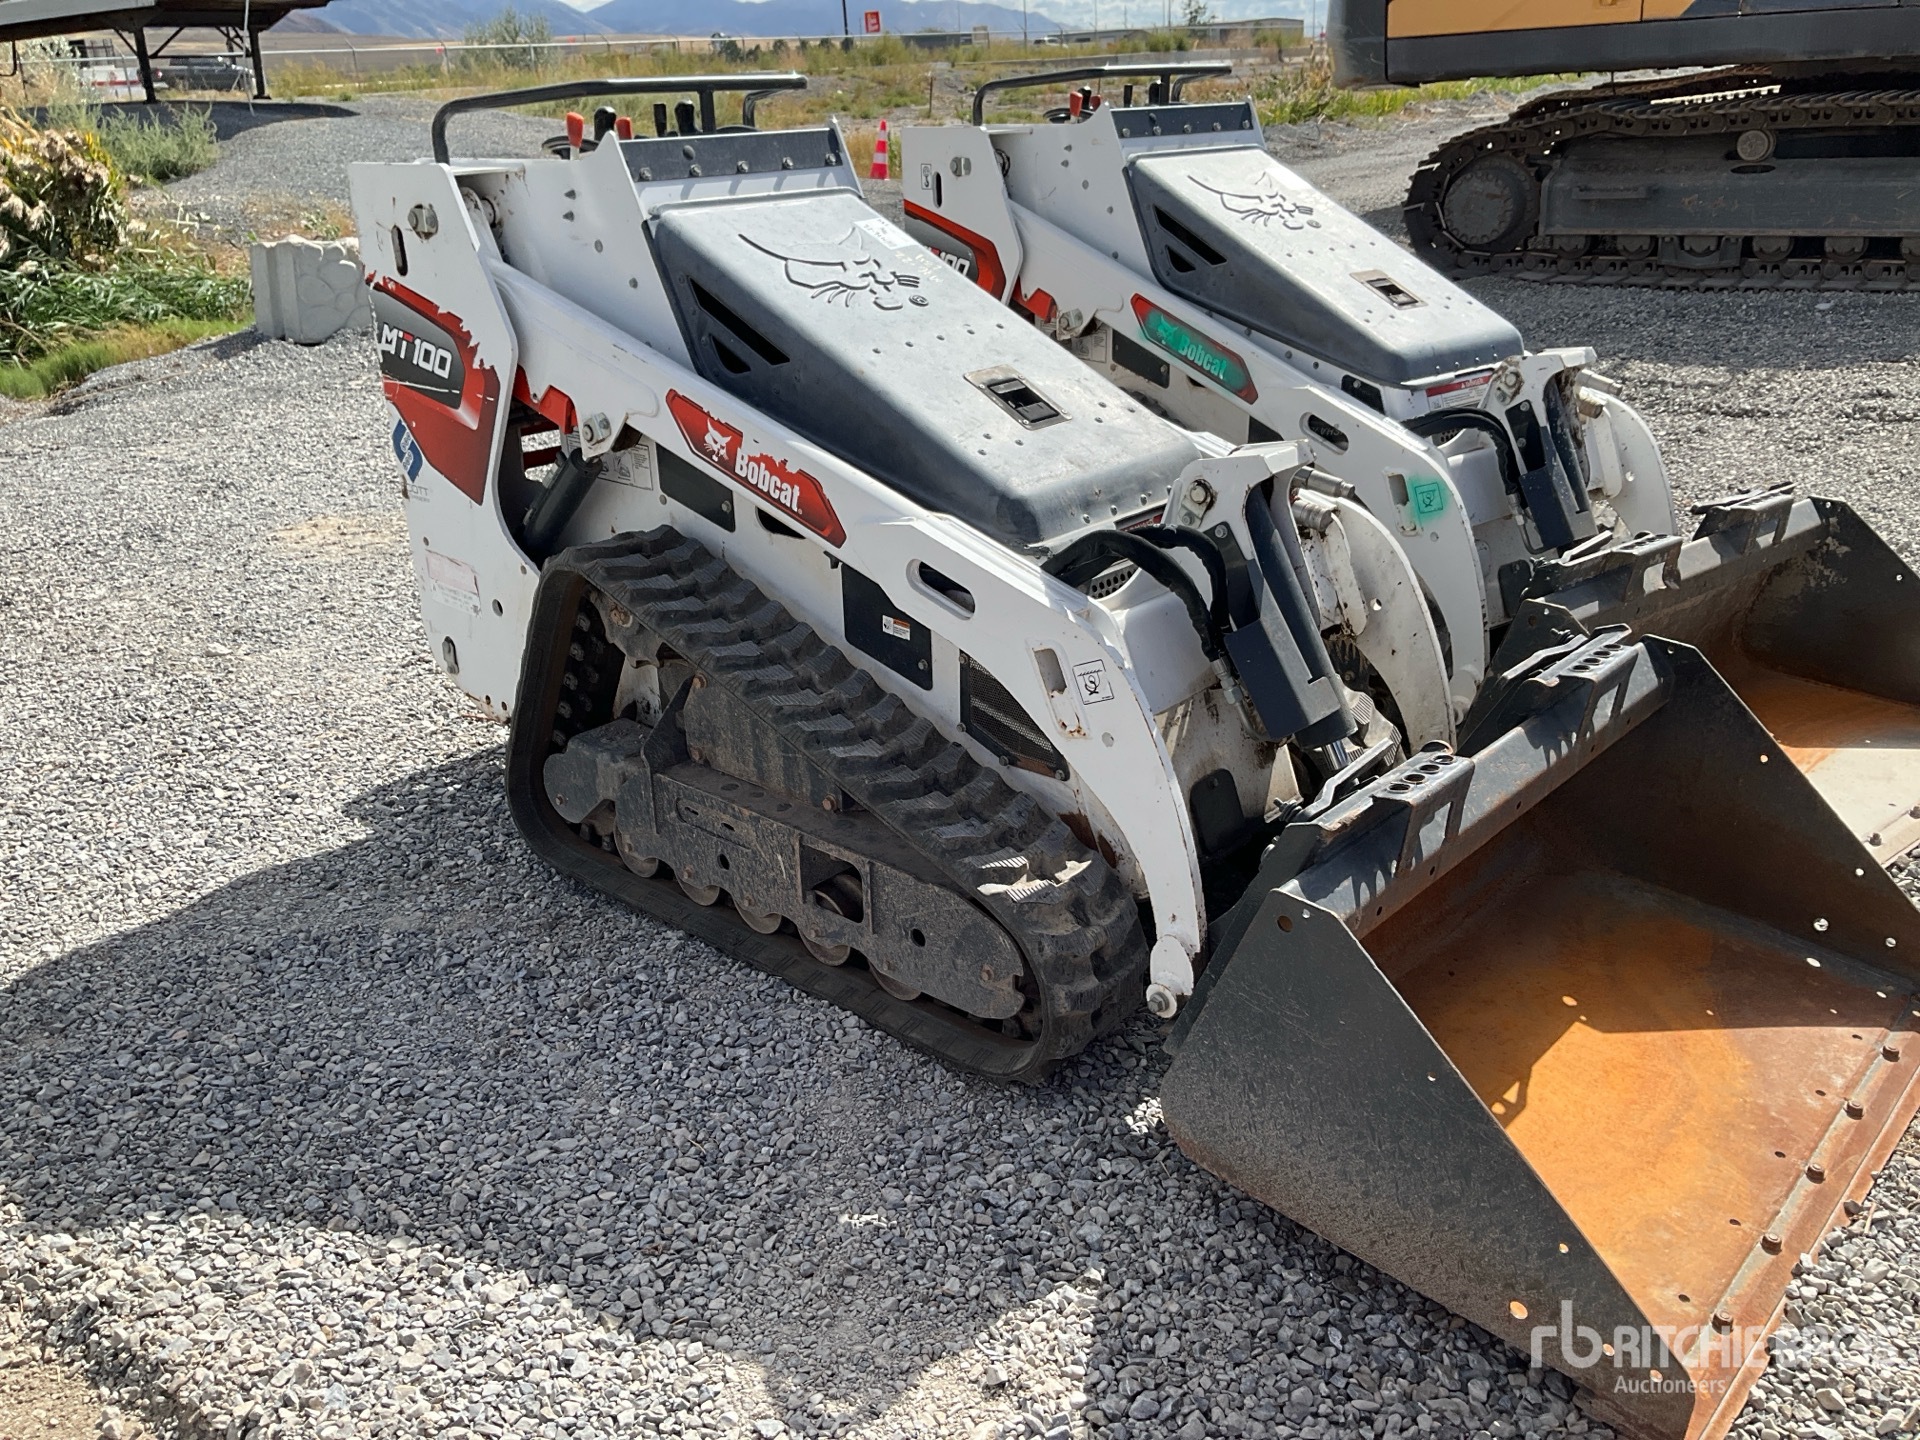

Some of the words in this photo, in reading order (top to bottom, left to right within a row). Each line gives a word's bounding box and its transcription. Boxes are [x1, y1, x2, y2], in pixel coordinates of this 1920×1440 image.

[381, 324, 452, 379] MT100
[1177, 334, 1228, 380] Bobcat
[735, 447, 801, 513] Bobcat
